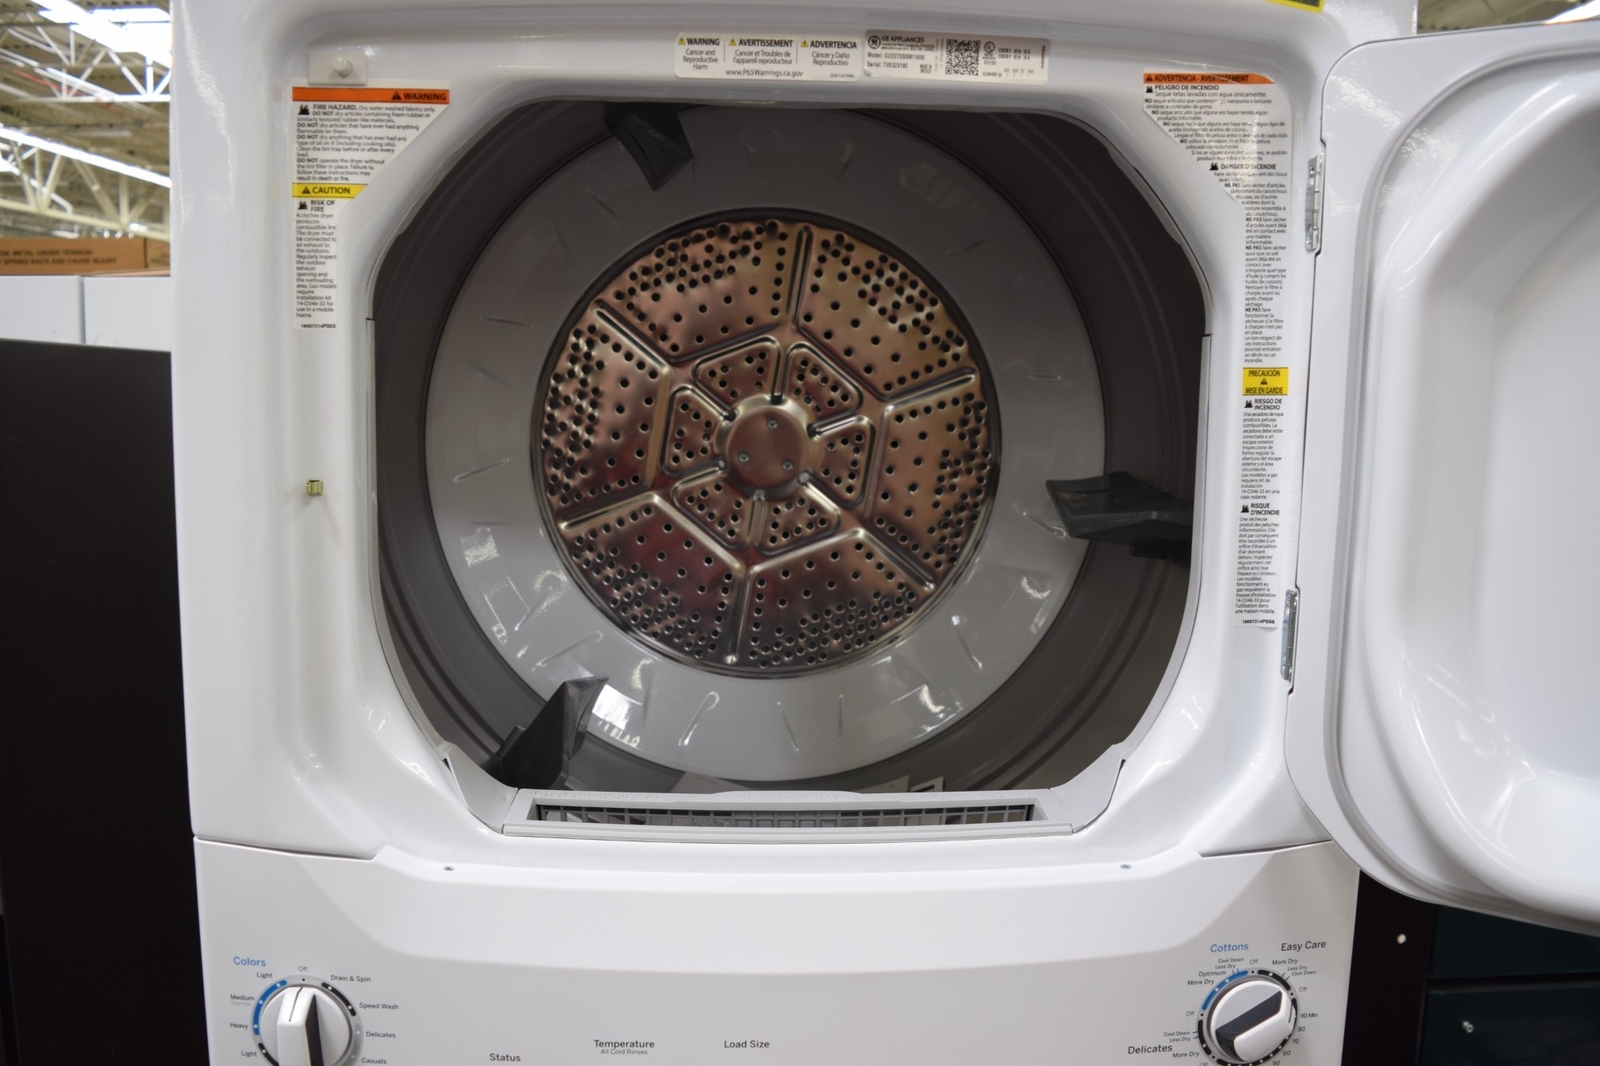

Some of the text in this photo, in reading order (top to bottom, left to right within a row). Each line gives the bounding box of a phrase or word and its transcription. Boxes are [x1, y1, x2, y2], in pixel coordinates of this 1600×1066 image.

[686, 38, 720, 46] WARNING
[738, 39, 793, 47] AVERTISSEMENT
[810, 40, 857, 49] ADVERTENCIA
[726, 69, 804, 78] www.P65Warnings.ca.gov
[403, 92, 447, 101] WARNING
[1248, 369, 1280, 377] PRECAUCIÓN
[1210, 944, 1248, 953] Cottons
[1281, 941, 1326, 952] Easy Care
[233, 956, 266, 966] Colors
[594, 1039, 655, 1049] Temperature
[724, 1040, 770, 1048] Load Size
[1128, 1045, 1173, 1054] Delicates
[490, 1053, 521, 1062] Status
